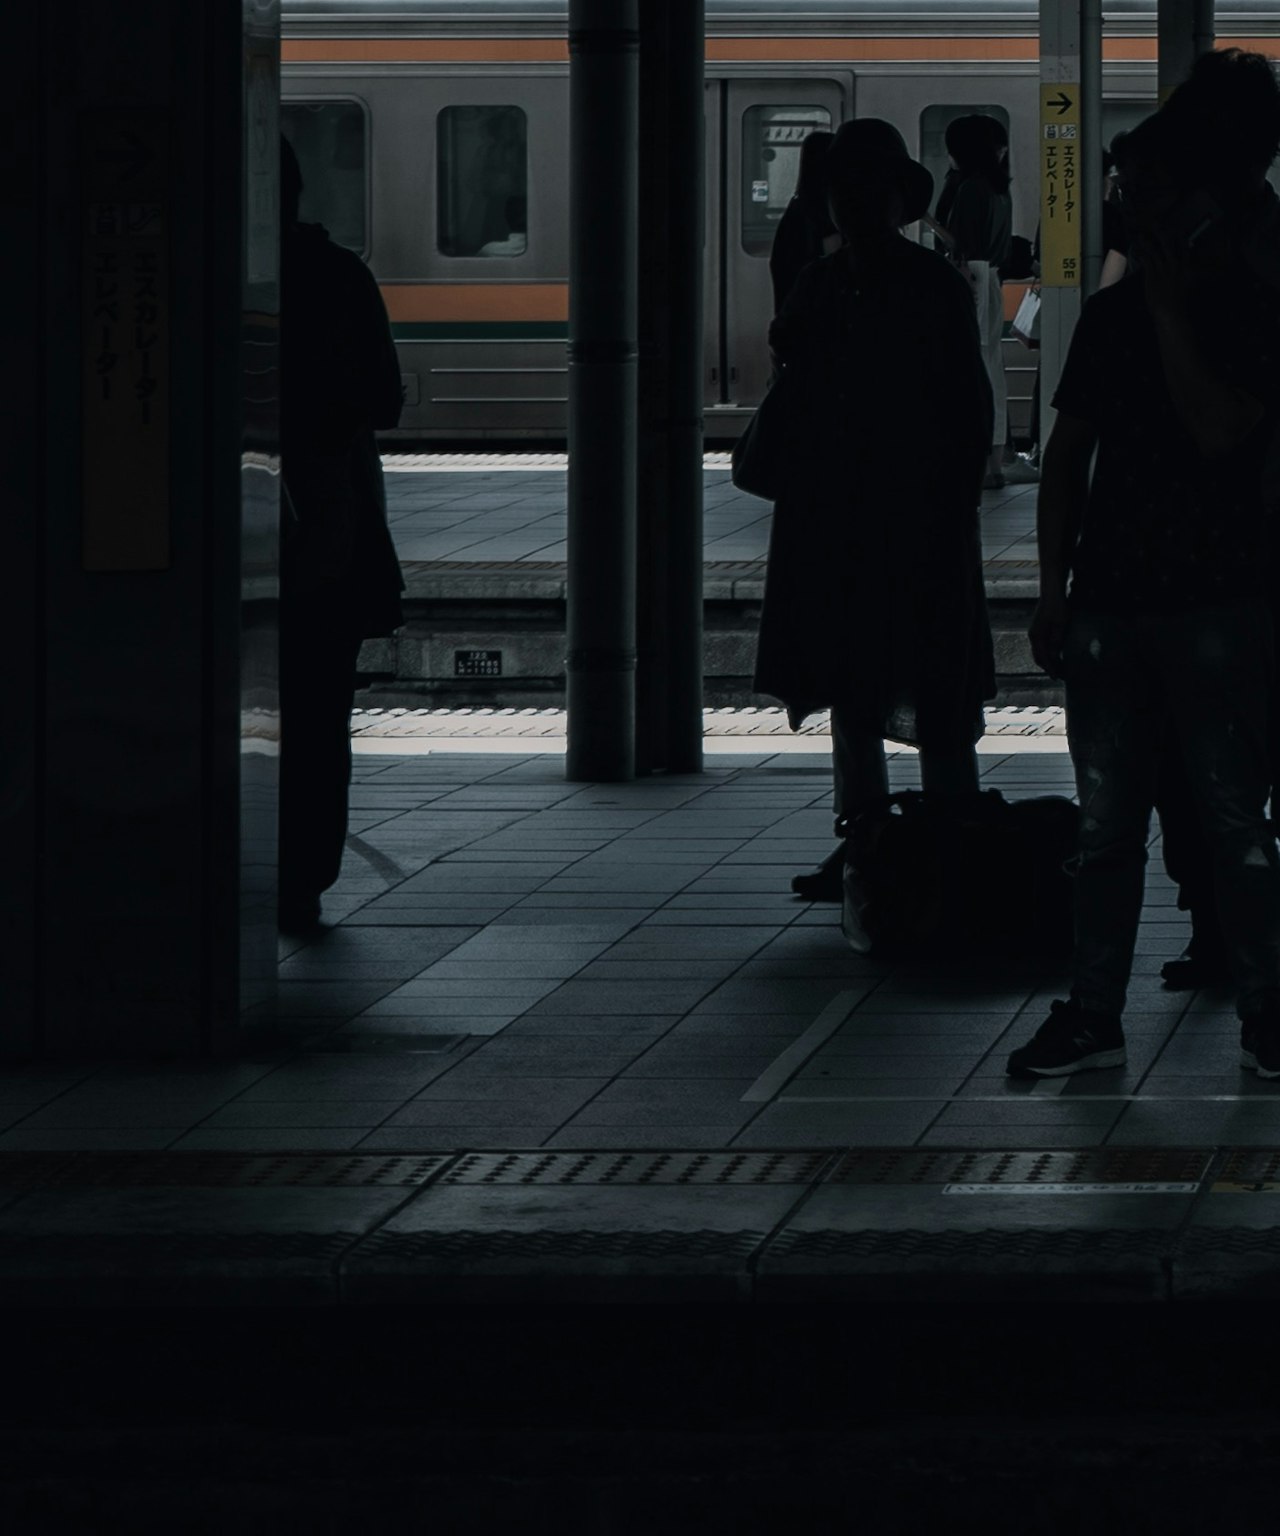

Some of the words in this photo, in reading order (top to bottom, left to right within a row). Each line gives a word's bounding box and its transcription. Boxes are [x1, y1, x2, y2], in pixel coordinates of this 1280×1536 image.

[1046, 145, 1058, 218] エレベーター
[1063, 145, 1075, 222] エスカレーター
[1062, 258, 1076, 269] 55
[1064, 271, 1075, 279] m
